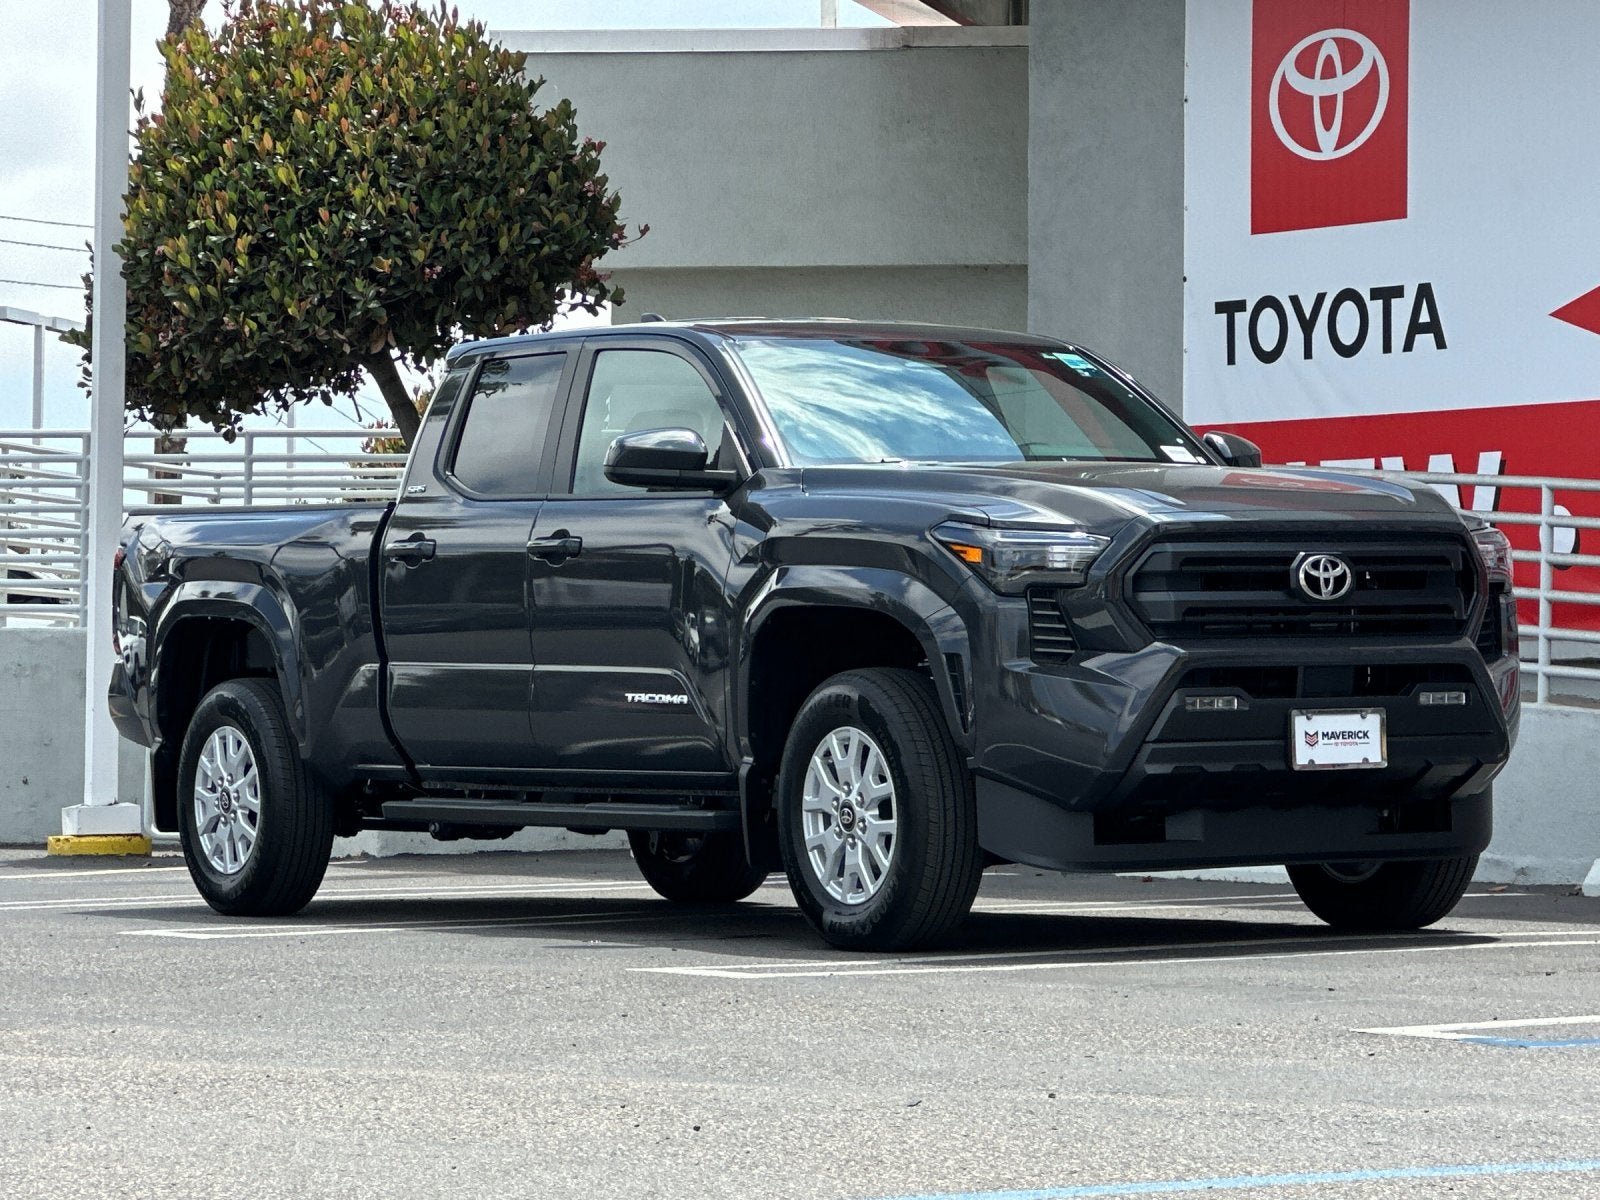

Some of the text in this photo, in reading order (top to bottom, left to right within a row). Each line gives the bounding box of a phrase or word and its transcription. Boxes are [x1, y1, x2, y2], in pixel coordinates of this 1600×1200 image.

[1215, 282, 1447, 365] TOYOTA
[624, 692, 688, 704] TACOMA
[1321, 730, 1369, 740] MAVERICK
